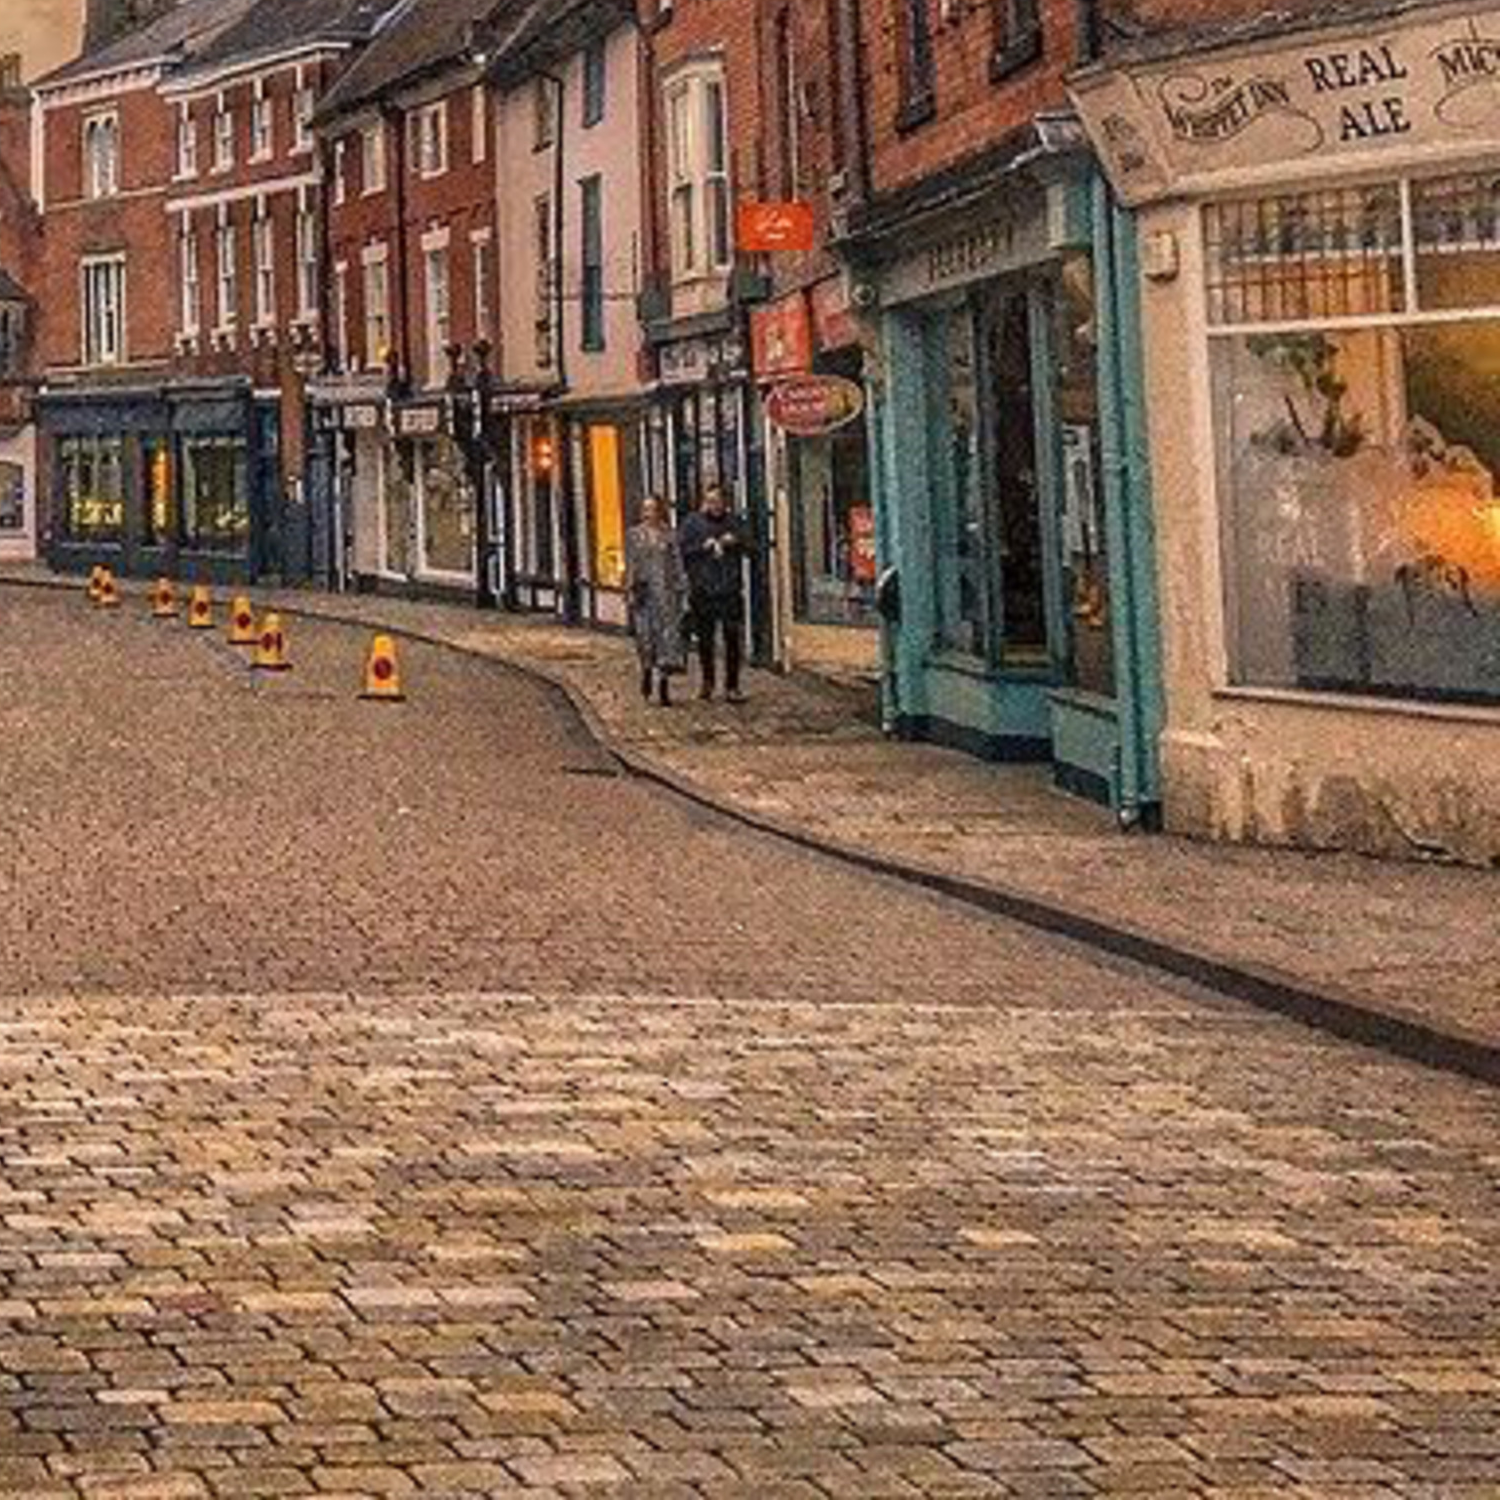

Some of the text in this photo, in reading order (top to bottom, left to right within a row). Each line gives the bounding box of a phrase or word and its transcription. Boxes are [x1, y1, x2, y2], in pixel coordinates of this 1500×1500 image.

[1304, 46, 1408, 92] REAL
[1436, 45, 1500, 87] MIC
[1339, 97, 1412, 142] ALE
